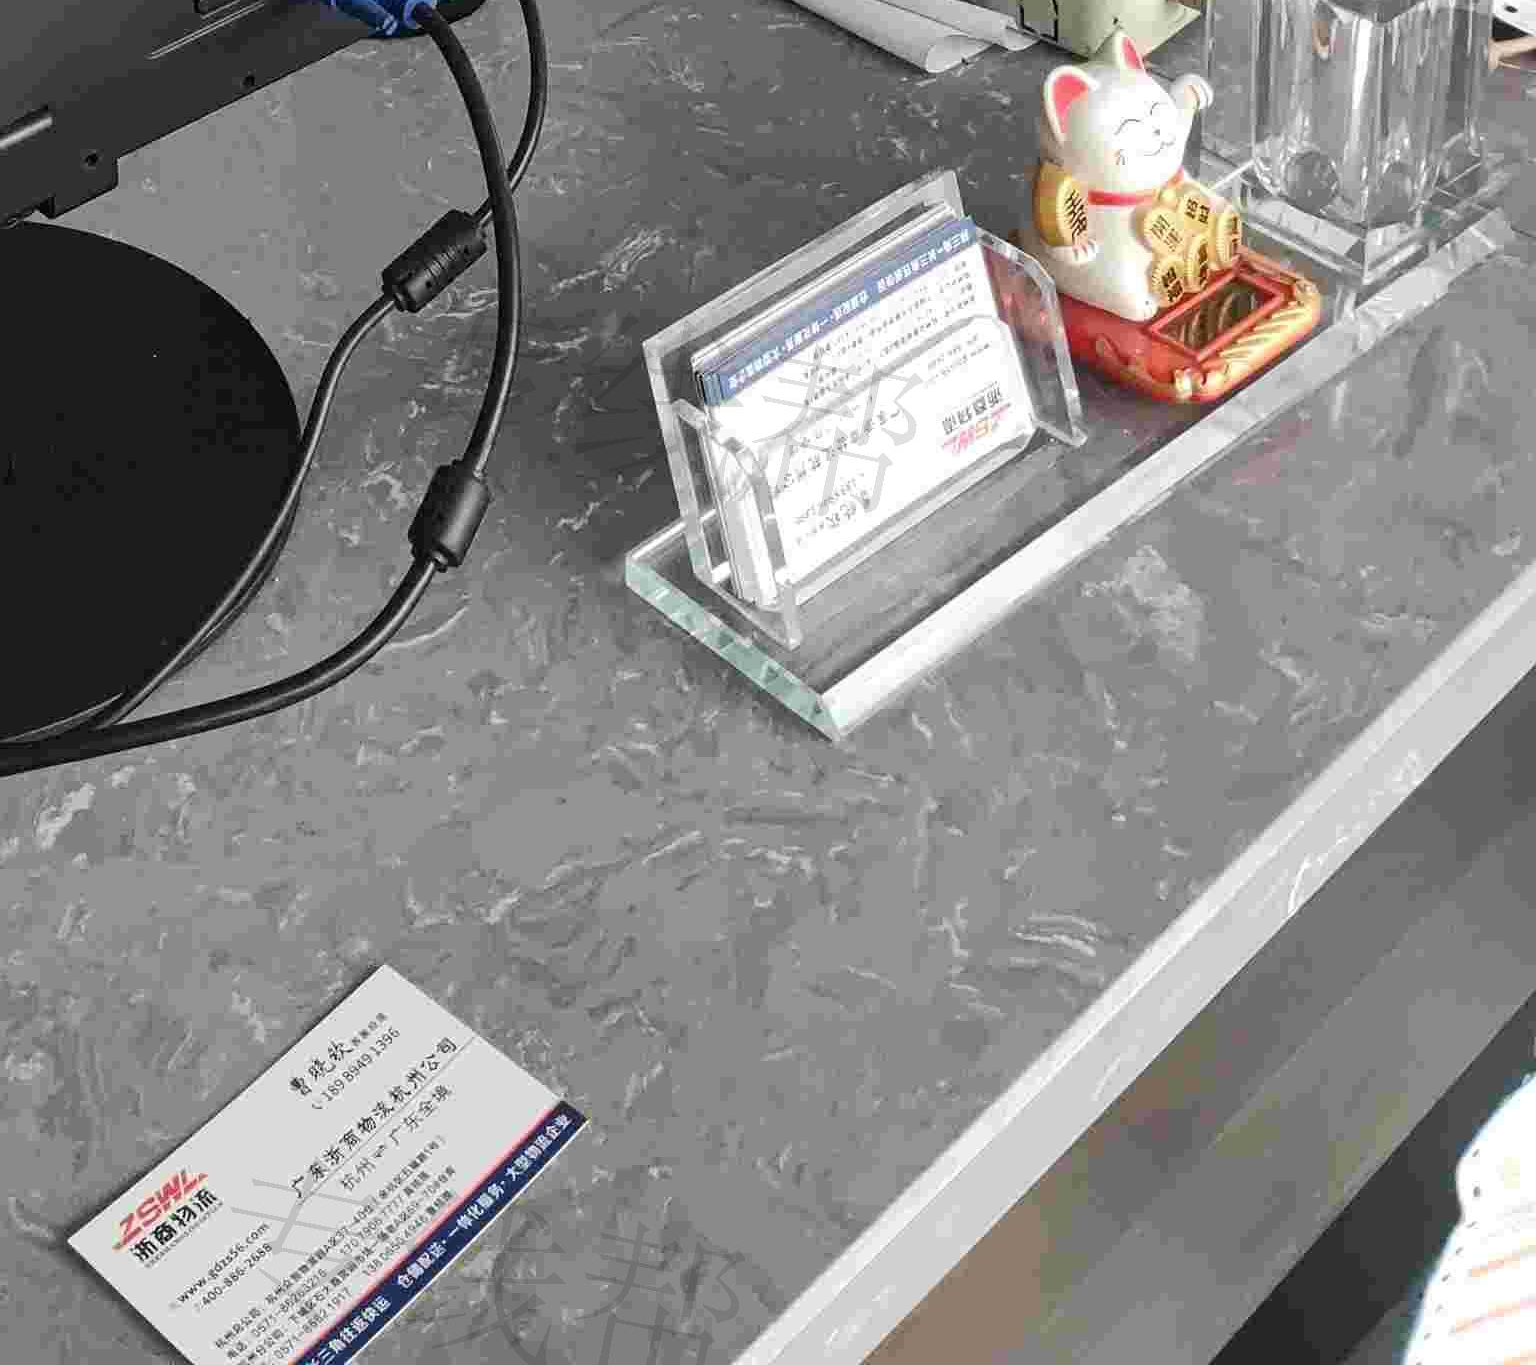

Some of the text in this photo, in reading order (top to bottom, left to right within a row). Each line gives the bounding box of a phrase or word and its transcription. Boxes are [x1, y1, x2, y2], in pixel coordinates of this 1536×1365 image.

[114, 1169, 208, 1252] ZSWL
[129, 1187, 218, 1262] 浙商物流
